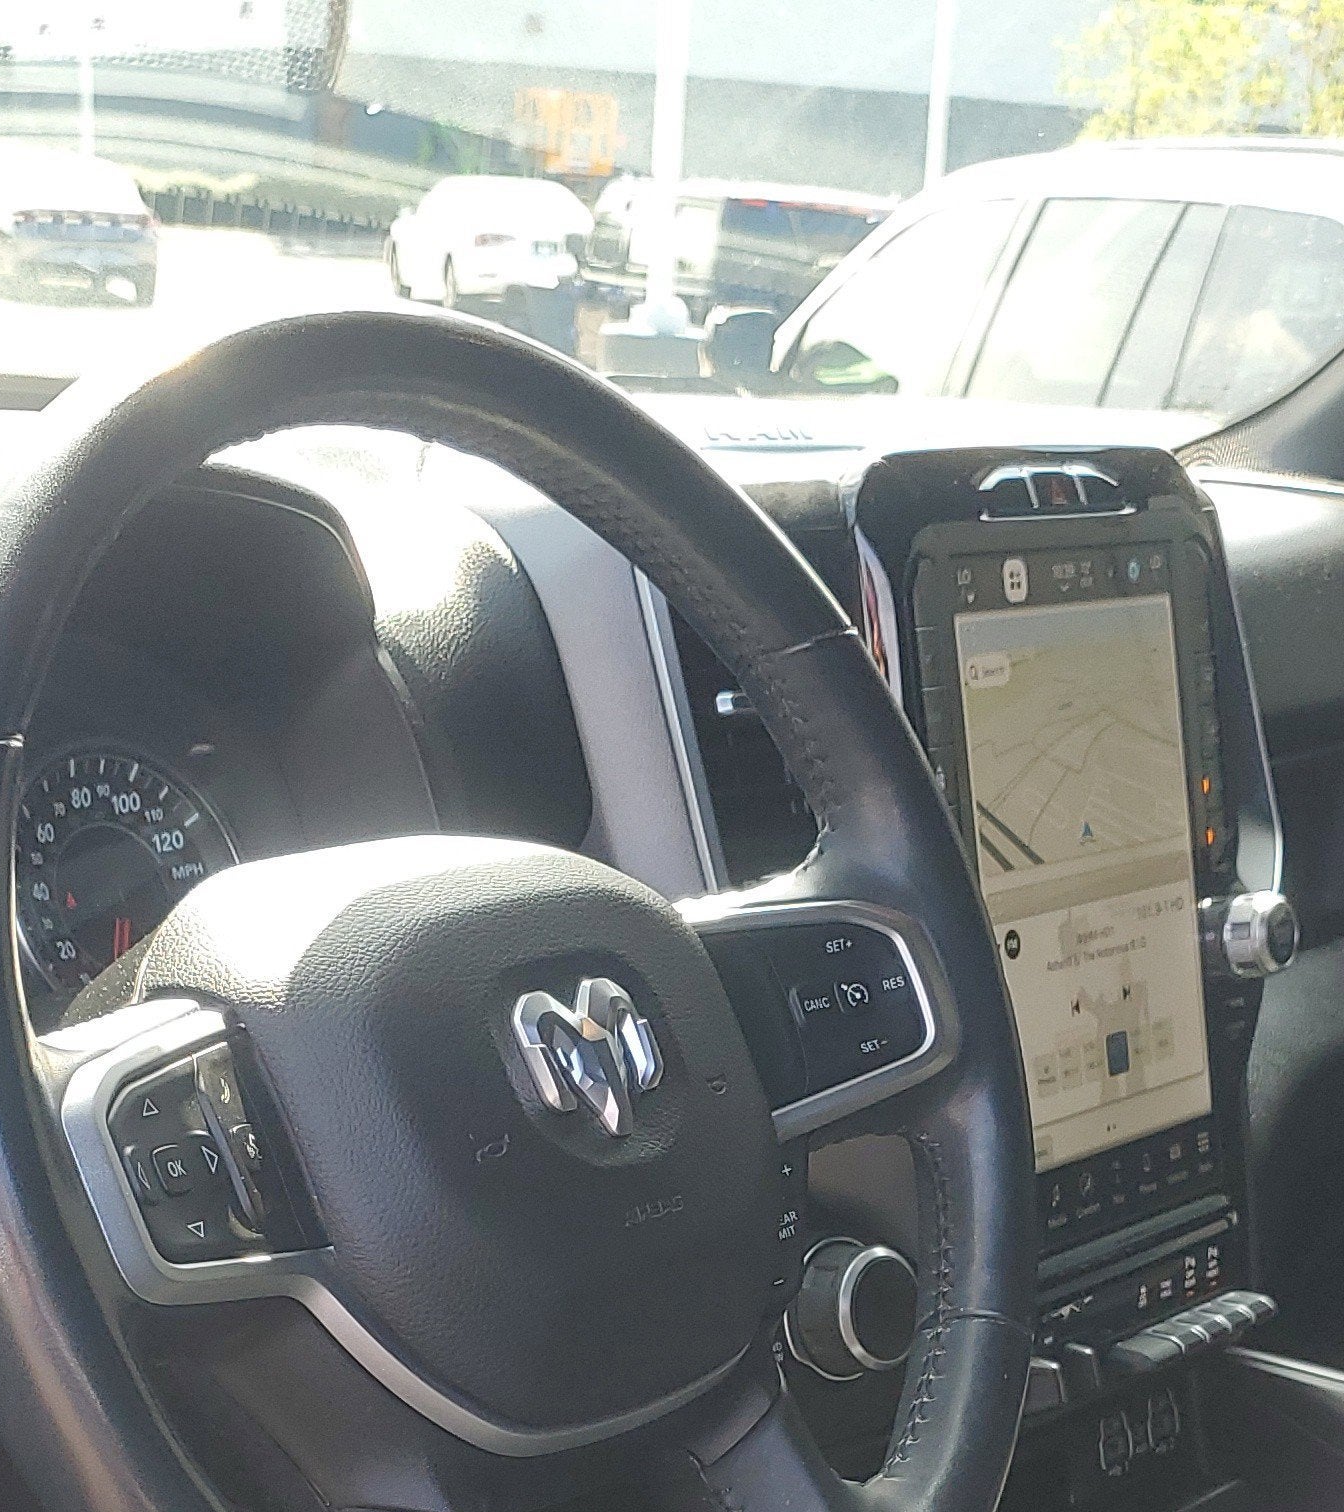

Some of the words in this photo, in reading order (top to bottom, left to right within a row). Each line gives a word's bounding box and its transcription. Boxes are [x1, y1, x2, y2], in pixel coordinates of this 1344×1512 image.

[71, 786, 92, 809] 80
[112, 791, 141, 815] 100
[37, 822, 55, 843] 60
[152, 830, 184, 852] 120
[172, 862, 204, 880] MPH
[32, 882, 50, 901] 40
[56, 941, 77, 960] 20
[882, 976, 906, 991] RES
[803, 997, 830, 1012] CANC
[167, 1160, 187, 1178] OK
